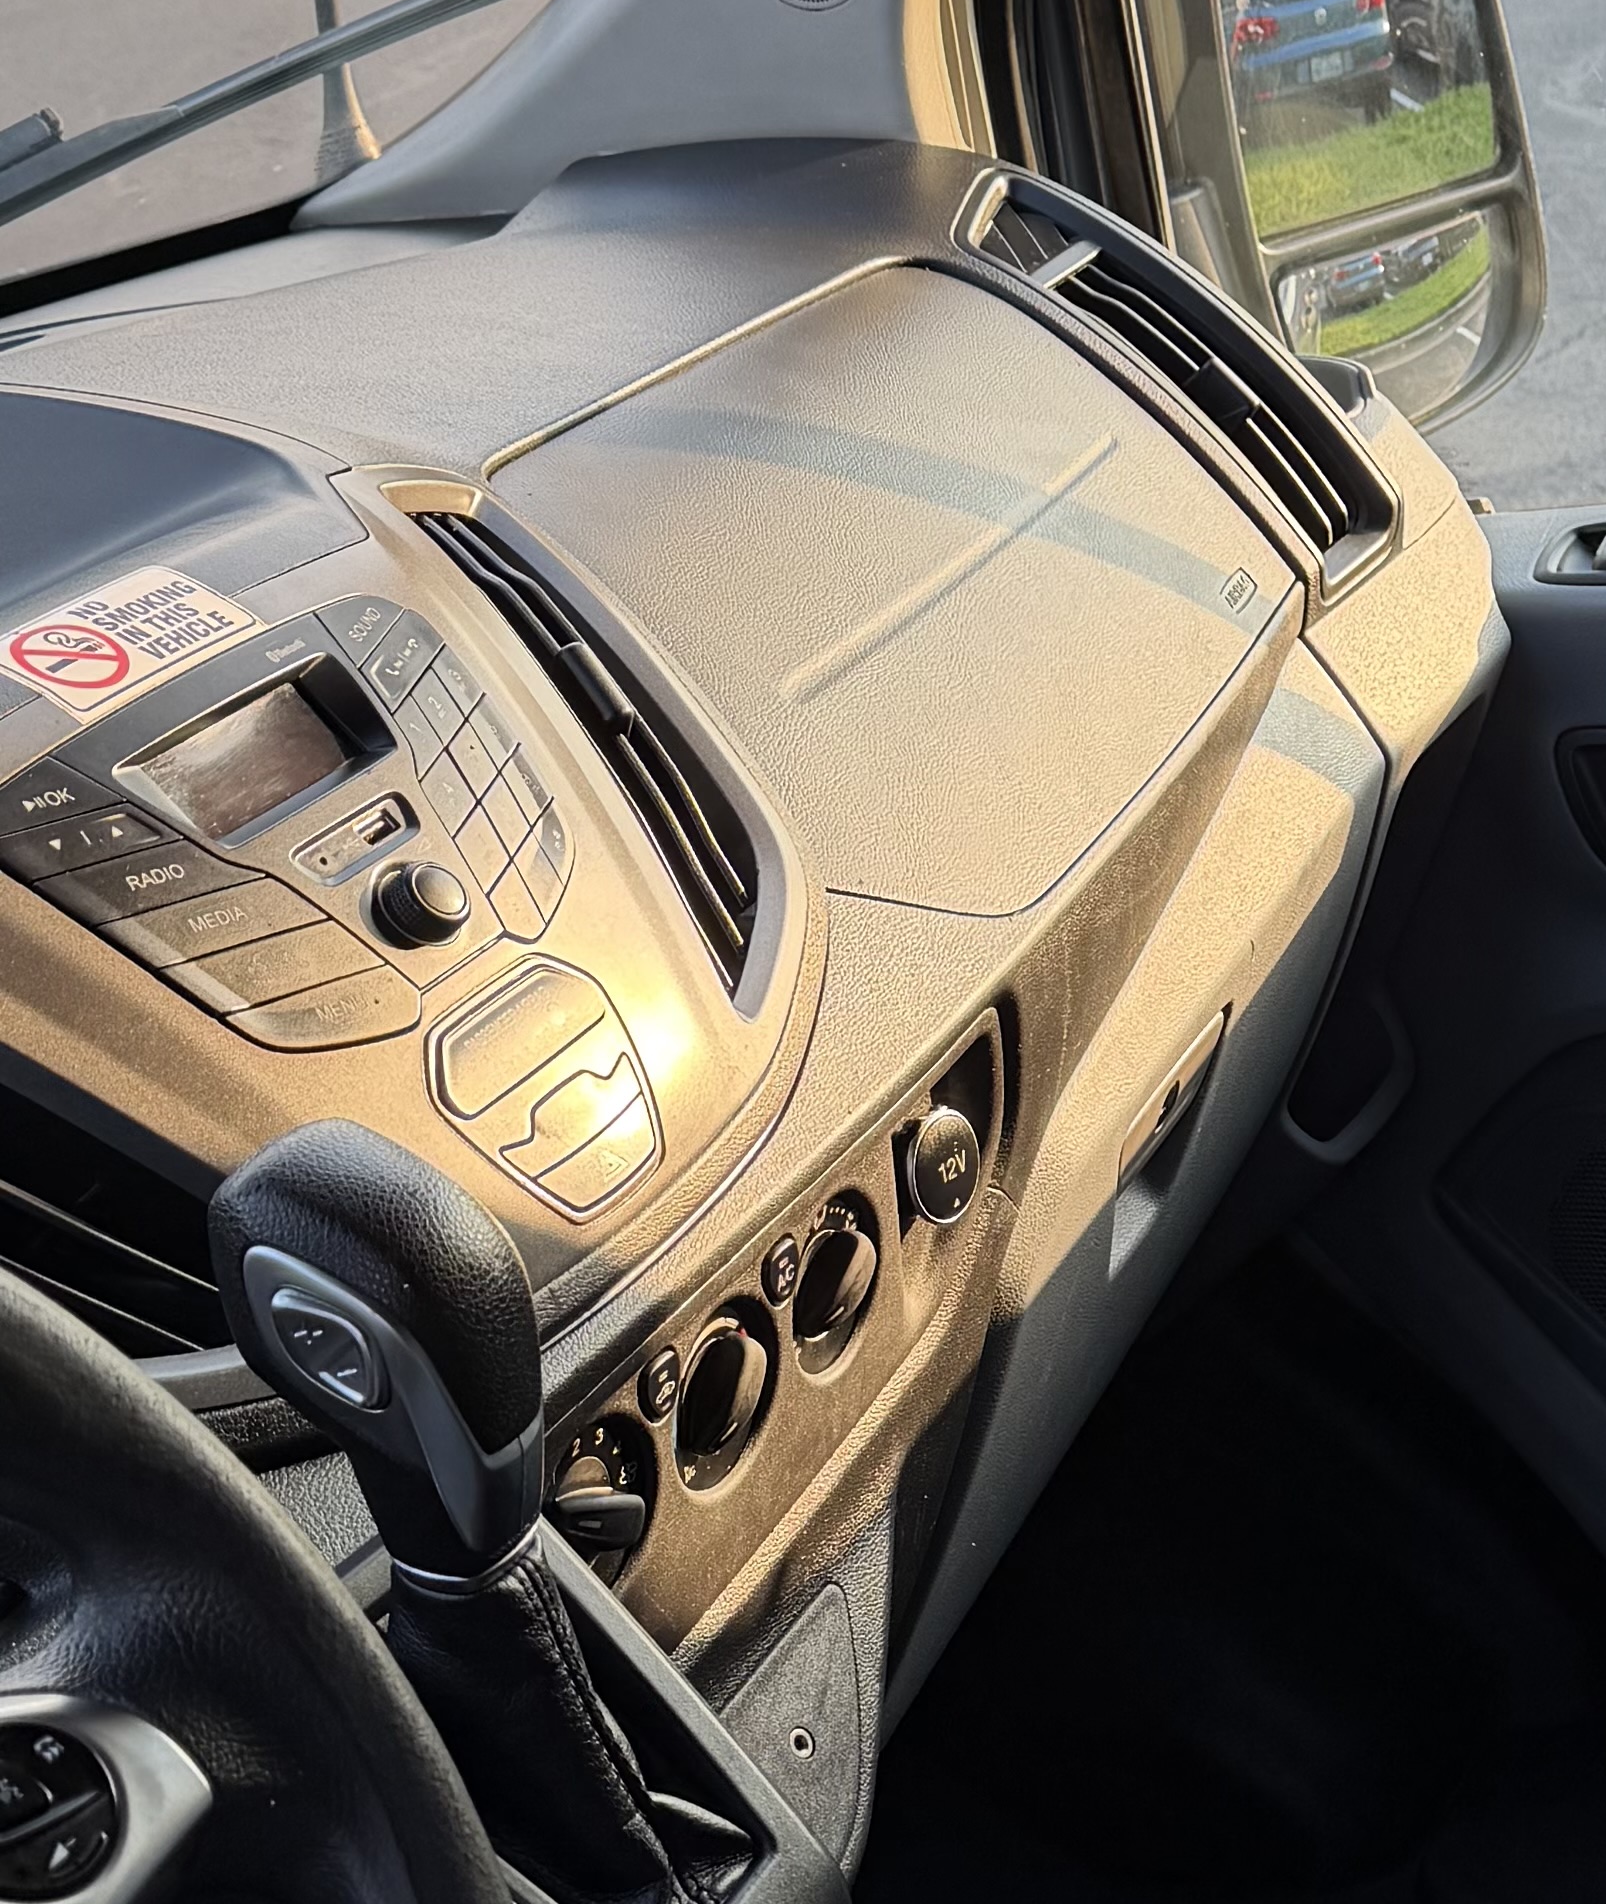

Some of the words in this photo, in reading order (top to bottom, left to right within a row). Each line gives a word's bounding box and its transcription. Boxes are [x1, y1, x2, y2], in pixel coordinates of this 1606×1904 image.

[67, 600, 109, 620] NO
[92, 580, 197, 632] SMOKING
[115, 624, 152, 645] IN
[140, 602, 199, 631] THIS
[137, 610, 235, 660] VEHICLE
[348, 607, 382, 642] SOUND
[45, 787, 76, 807] OK
[125, 863, 185, 892] RADIO
[187, 905, 249, 933] MEDIA
[938, 1149, 966, 1184] 12V
[571, 1437, 581, 1458] 2
[595, 1427, 604, 1446] 3
